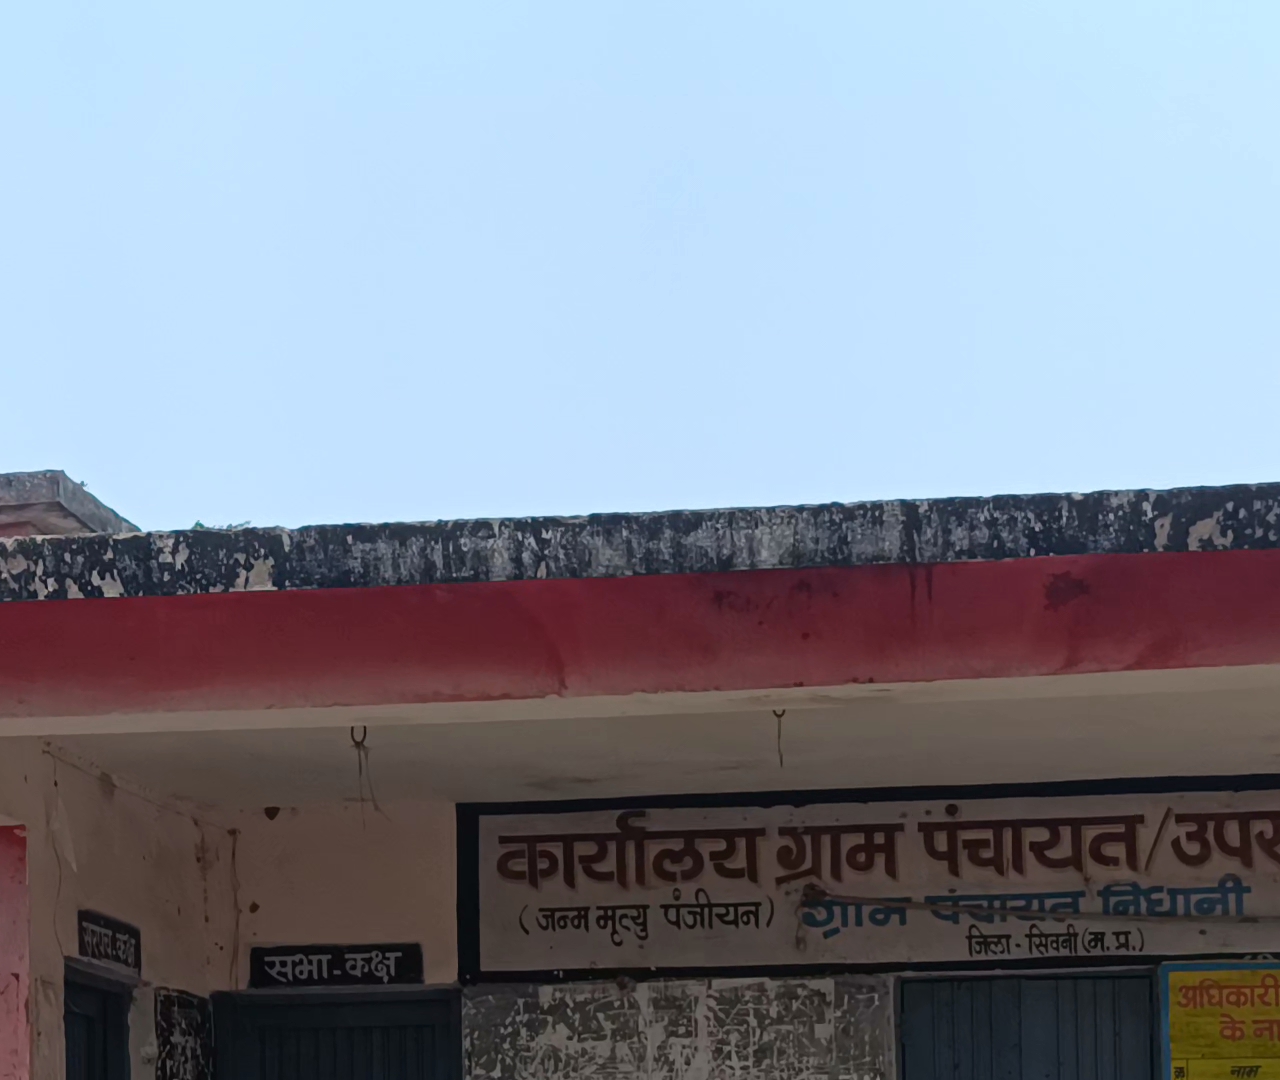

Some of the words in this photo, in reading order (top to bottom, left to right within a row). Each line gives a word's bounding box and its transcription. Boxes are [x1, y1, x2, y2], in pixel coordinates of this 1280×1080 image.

[496, 810, 766, 889] कार्यालय
[775, 822, 904, 885] ग्राम
[519, 903, 590, 935] (जन्म
[596, 903, 650, 947] मृत्यु
[660, 888, 775, 931] पंजीयन)
[802, 893, 912, 940] ग्राम
[925, 888, 1086, 924] पंचायत
[1097, 873, 1252, 918] निधानी
[966, 924, 1011, 957] जिला
[1025, 924, 1079, 956] सिवनी
[1220, 1014, 1247, 1041] के
[1230, 1065, 1262, 1078] नाम
